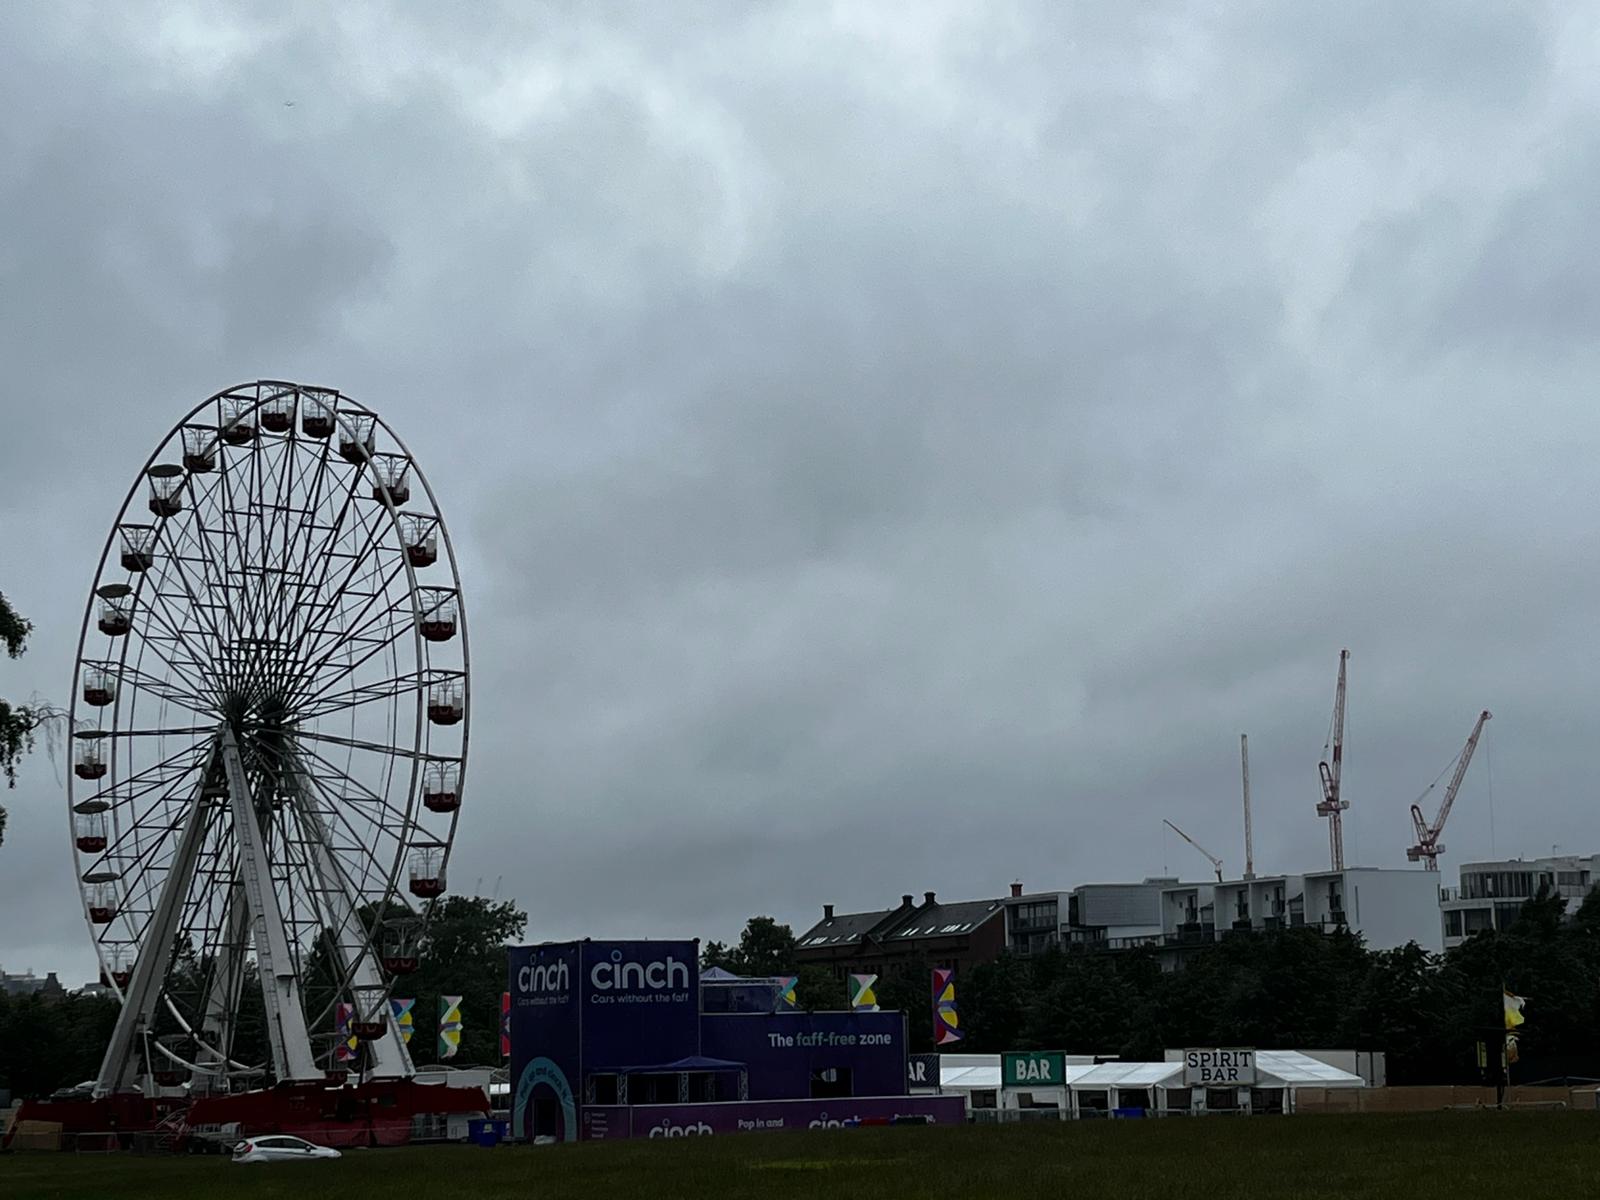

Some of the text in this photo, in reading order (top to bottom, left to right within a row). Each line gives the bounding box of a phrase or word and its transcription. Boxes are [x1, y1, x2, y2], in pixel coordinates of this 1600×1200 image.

[518, 953, 570, 992] cinch
[591, 949, 689, 990] cinch
[591, 992, 689, 1004] Cars without the faff
[768, 1031, 892, 1048] The faff-free zone
[1188, 1052, 1251, 1068] SPIRIT
[1015, 1058, 1052, 1081] BAR
[1201, 1068, 1238, 1081] BAR
[737, 1117, 784, 1131] Pop in and
